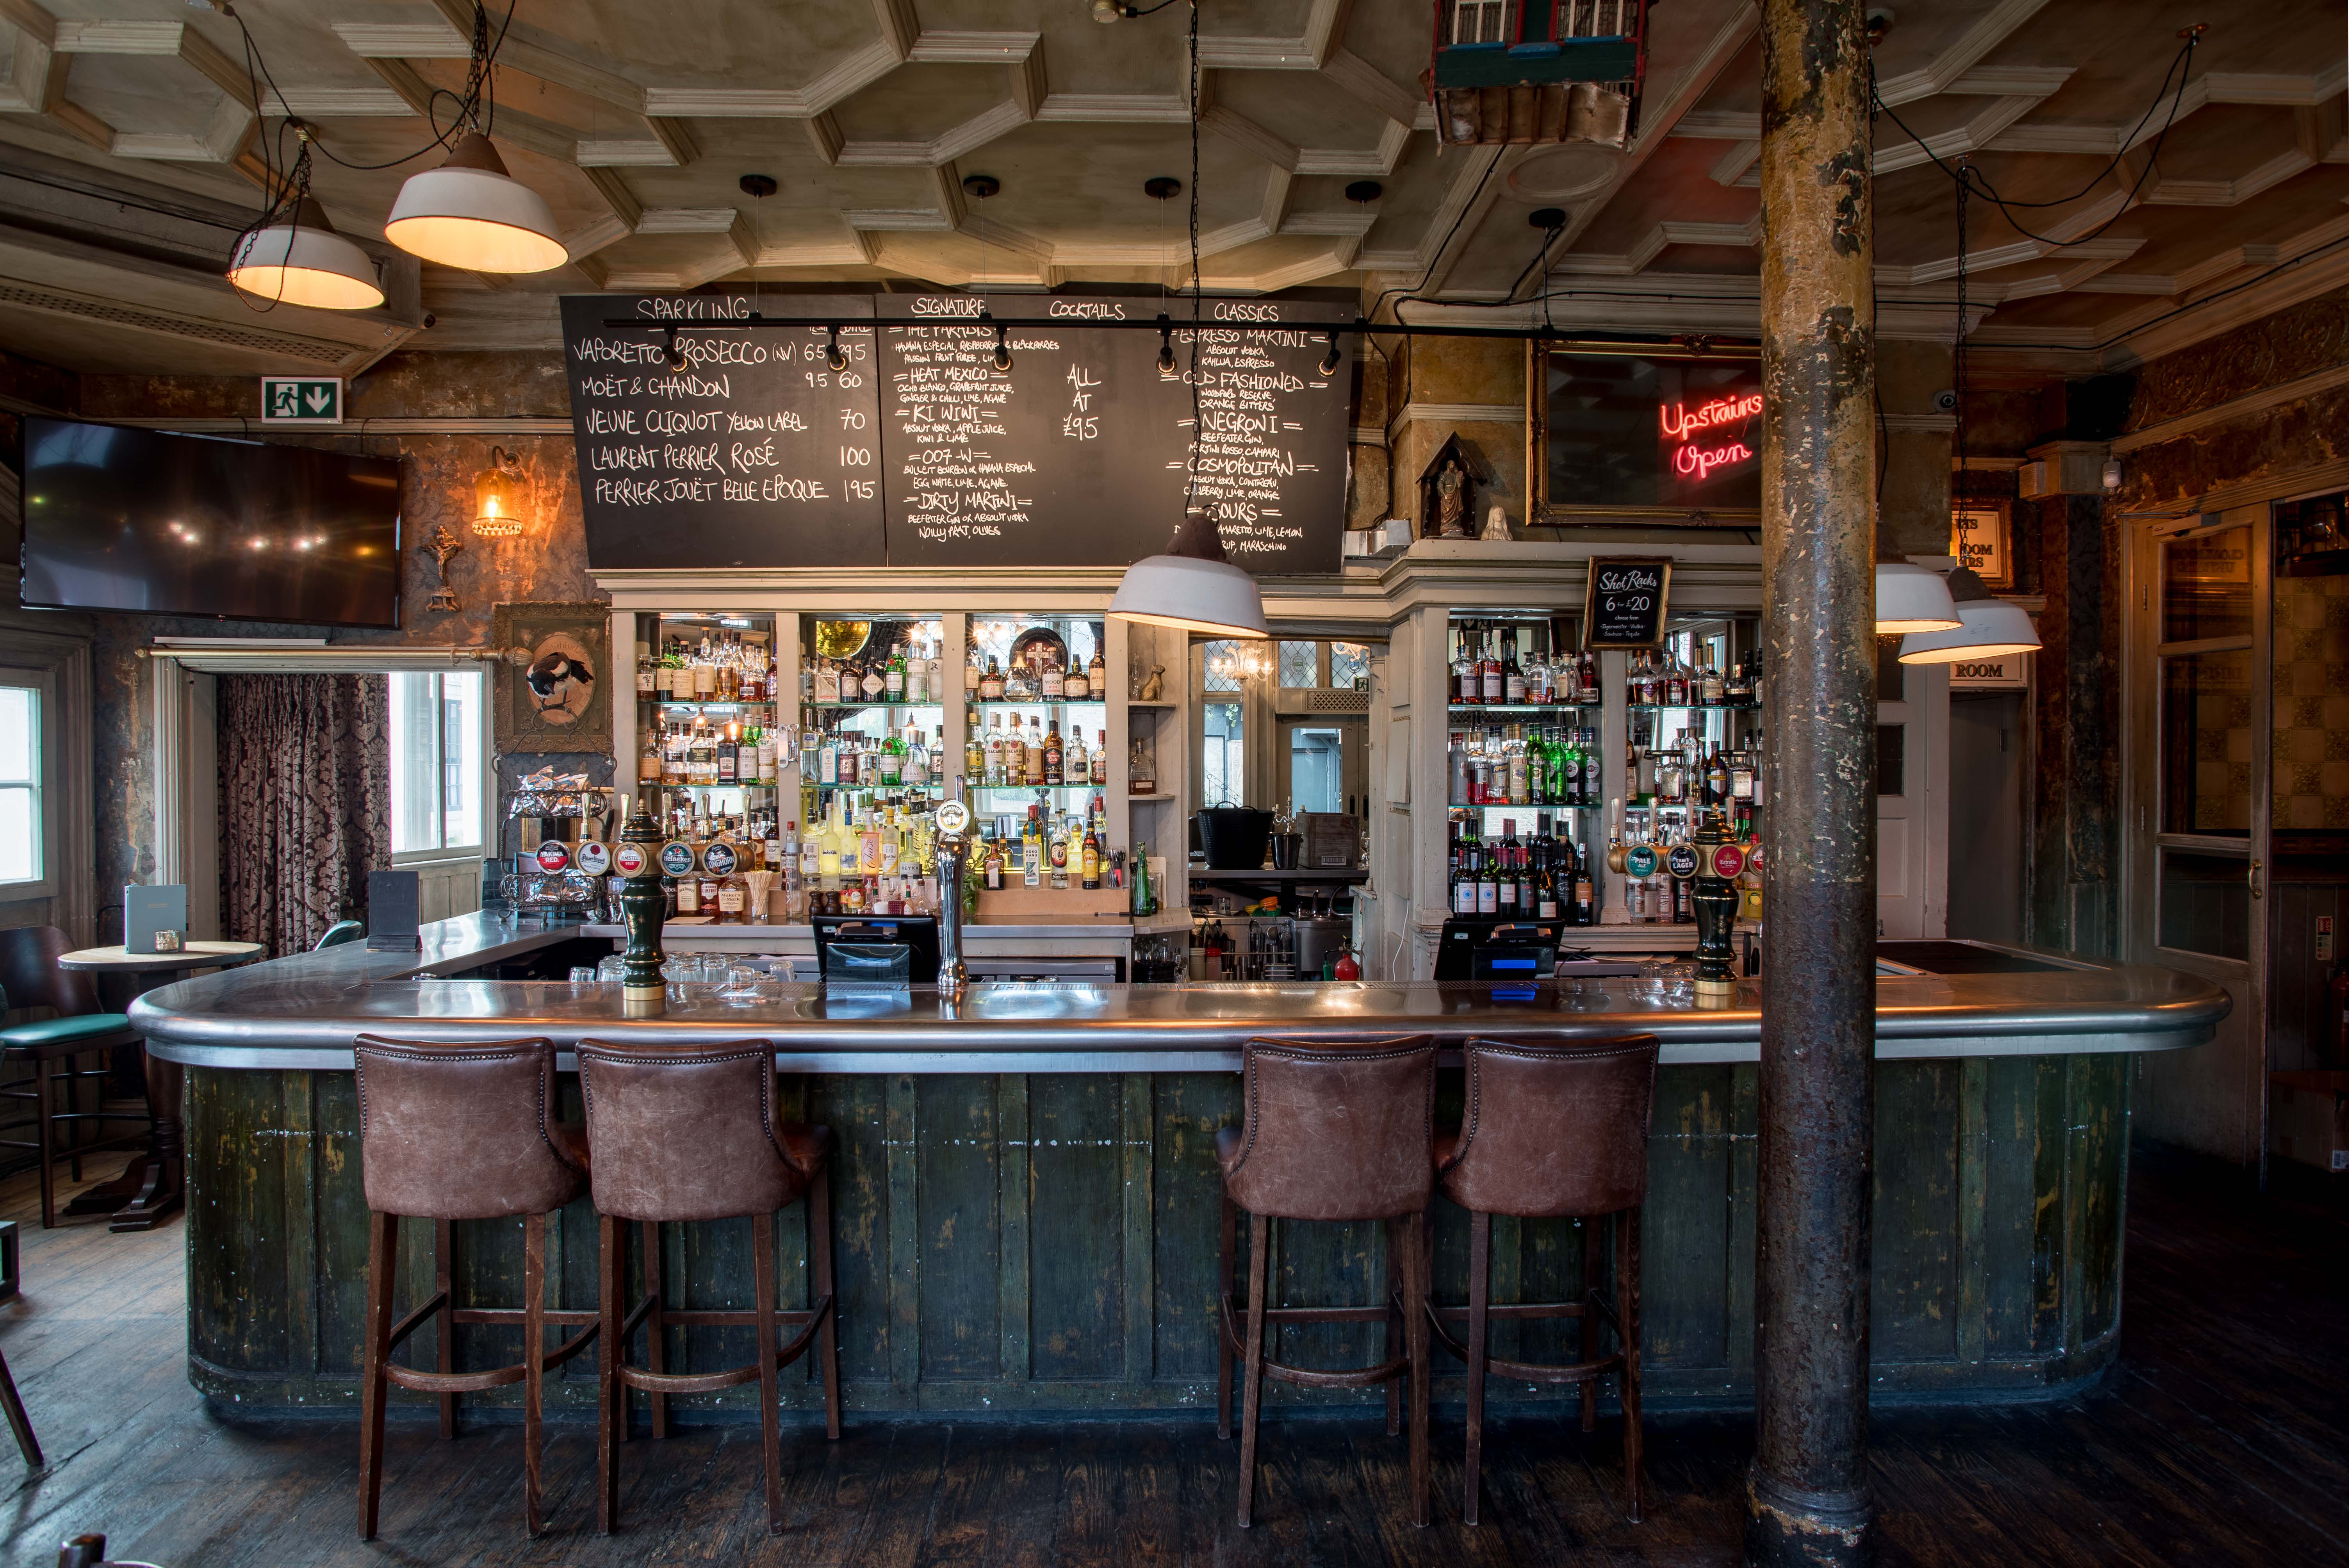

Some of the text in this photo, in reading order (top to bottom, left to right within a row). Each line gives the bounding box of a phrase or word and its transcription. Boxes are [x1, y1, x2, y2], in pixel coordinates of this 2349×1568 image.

[1050, 301, 1125, 320] COCKTAILS
[1215, 303, 1279, 322] CLASSICS
[1180, 329, 1307, 347] ESPRESSO MARTINI
[574, 337, 825, 369] VAPORETTO PROSECCO (NV) 6.5
[895, 341, 922, 353] HAVANA
[1013, 339, 1060, 350] BLACKBERRIES
[1206, 344, 1237, 355] ABSOLUT
[904, 353, 954, 364] PASSION FRUIT
[1235, 357, 1275, 370] ESPRESSO
[911, 366, 987, 383] HEAT MEXICO
[1067, 363, 1101, 390] ALL
[1220, 371, 1304, 392] FASHIONED
[582, 372, 862, 400] MOËT & CHANDON 9.5 60
[950, 382, 989, 391] GRAPEFRUIT
[1201, 388, 1236, 399] WOODFORD
[900, 393, 929, 403] GINGER
[931, 394, 937, 403] &
[984, 394, 1007, 403] AGAVE
[1073, 391, 1092, 412] AT
[1199, 399, 1274, 411] ORANGE BITTERS
[914, 404, 982, 423] KI WIWI
[1662, 395, 1762, 440] Upstairs
[586, 408, 640, 434] VEUVE
[645, 410, 723, 437] CLIQUOT
[768, 410, 807, 432] LABEL
[840, 409, 866, 430] 70
[903, 423, 930, 434] ABSOLUT
[957, 423, 982, 435] APPLE
[1063, 412, 1099, 441] £9.5
[1203, 411, 1278, 435] NEGRONI
[917, 434, 969, 443] KIWI & LIME
[1201, 432, 1244, 443] BEEFEATER
[592, 438, 870, 475] LAURENT PERRIER ROSÉ 100
[922, 449, 952, 465] 007
[1245, 447, 1280, 459] CAMPARI
[937, 465, 968, 475] BOURBON
[969, 465, 977, 474] OR
[978, 463, 1003, 473] HAVANA
[1005, 461, 1036, 473] ESPECIAL
[1187, 451, 1293, 477] COSMOPOLITAN
[1677, 444, 1752, 479] Open
[596, 474, 875, 506] PERRIER JOUËT BELLE EPOQUE 195
[913, 478, 930, 489] EGG
[978, 478, 1008, 489] AGAVE
[1249, 489, 1280, 500] ORANGE
[918, 490, 1017, 515] DIRTY MARTINI
[908, 513, 1028, 524] BEEFEATER GIN OR ABSOLUT VODKA
[919, 526, 946, 542] NOILLY
[972, 526, 1001, 536] OLIVES
[1240, 540, 1287, 551] MARASCHINO
[1599, 570, 1657, 591] Shot Racks
[1606, 597, 1615, 611] 6
[1626, 597, 1650, 611] £20
[1955, 664, 2003, 677] ROOM
[942, 805, 962, 815] SYMONDS
[581, 854, 593, 862] Pilsner
[706, 856, 734, 870] LONGHORN
